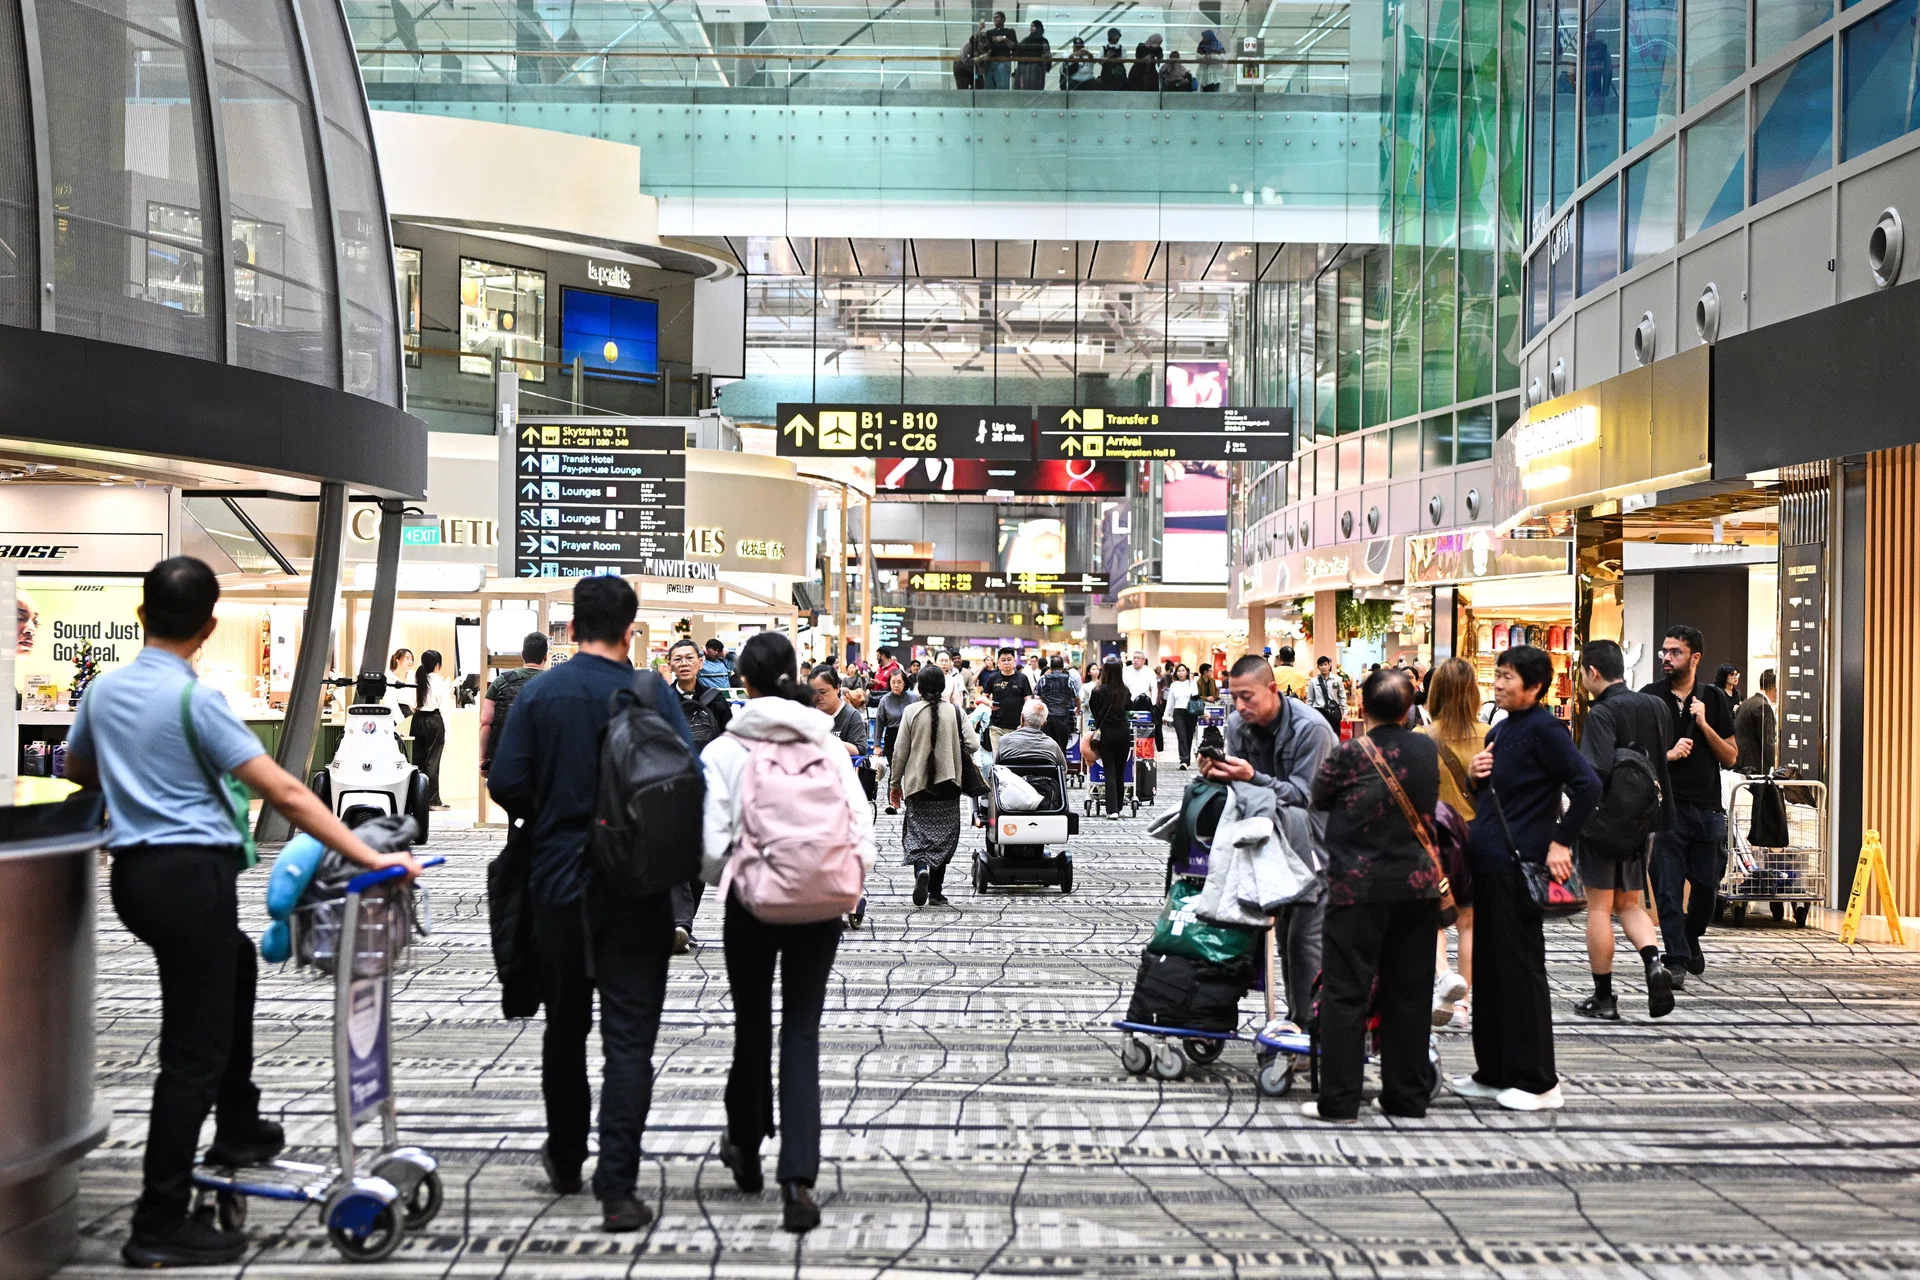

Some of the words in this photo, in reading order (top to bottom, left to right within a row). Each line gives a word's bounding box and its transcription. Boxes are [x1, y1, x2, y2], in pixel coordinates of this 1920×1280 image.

[861, 411, 883, 430] B1
[902, 411, 938, 430] B10
[1106, 413, 1149, 425] Transfer
[1151, 414, 1159, 425] B
[562, 427, 601, 439] Skytrain
[602, 428, 613, 437] to
[615, 427, 626, 437] T1
[1006, 423, 1017, 432] to
[562, 438, 571, 446] C1
[860, 433, 882, 451] C1
[901, 433, 937, 451] C26
[1106, 435, 1142, 447] Arrival
[562, 455, 590, 464] Transit
[593, 455, 614, 464] Hotel
[1105, 448, 1152, 459] Immigration
[1153, 448, 1168, 458] Hall
[1169, 448, 1176, 458] B
[562, 465, 610, 476] Pay-per-use
[611, 466, 642, 478] Lounge
[562, 486, 601, 498] Lounges
[562, 514, 600, 526] Lounges
[413, 529, 437, 542] EXIT
[561, 540, 591, 553] Prayer
[593, 541, 620, 551] Room
[561, 567, 592, 577] Toilets
[655, 559, 691, 579] INVITE
[692, 562, 720, 581] ONLY
[73, 584, 107, 592] BOSE
[665, 583, 695, 595] JEWELLERY
[53, 620, 101, 640] Sound
[105, 621, 140, 640] Just
[53, 643, 79, 662] Got
[86, 644, 120, 662] eal.
